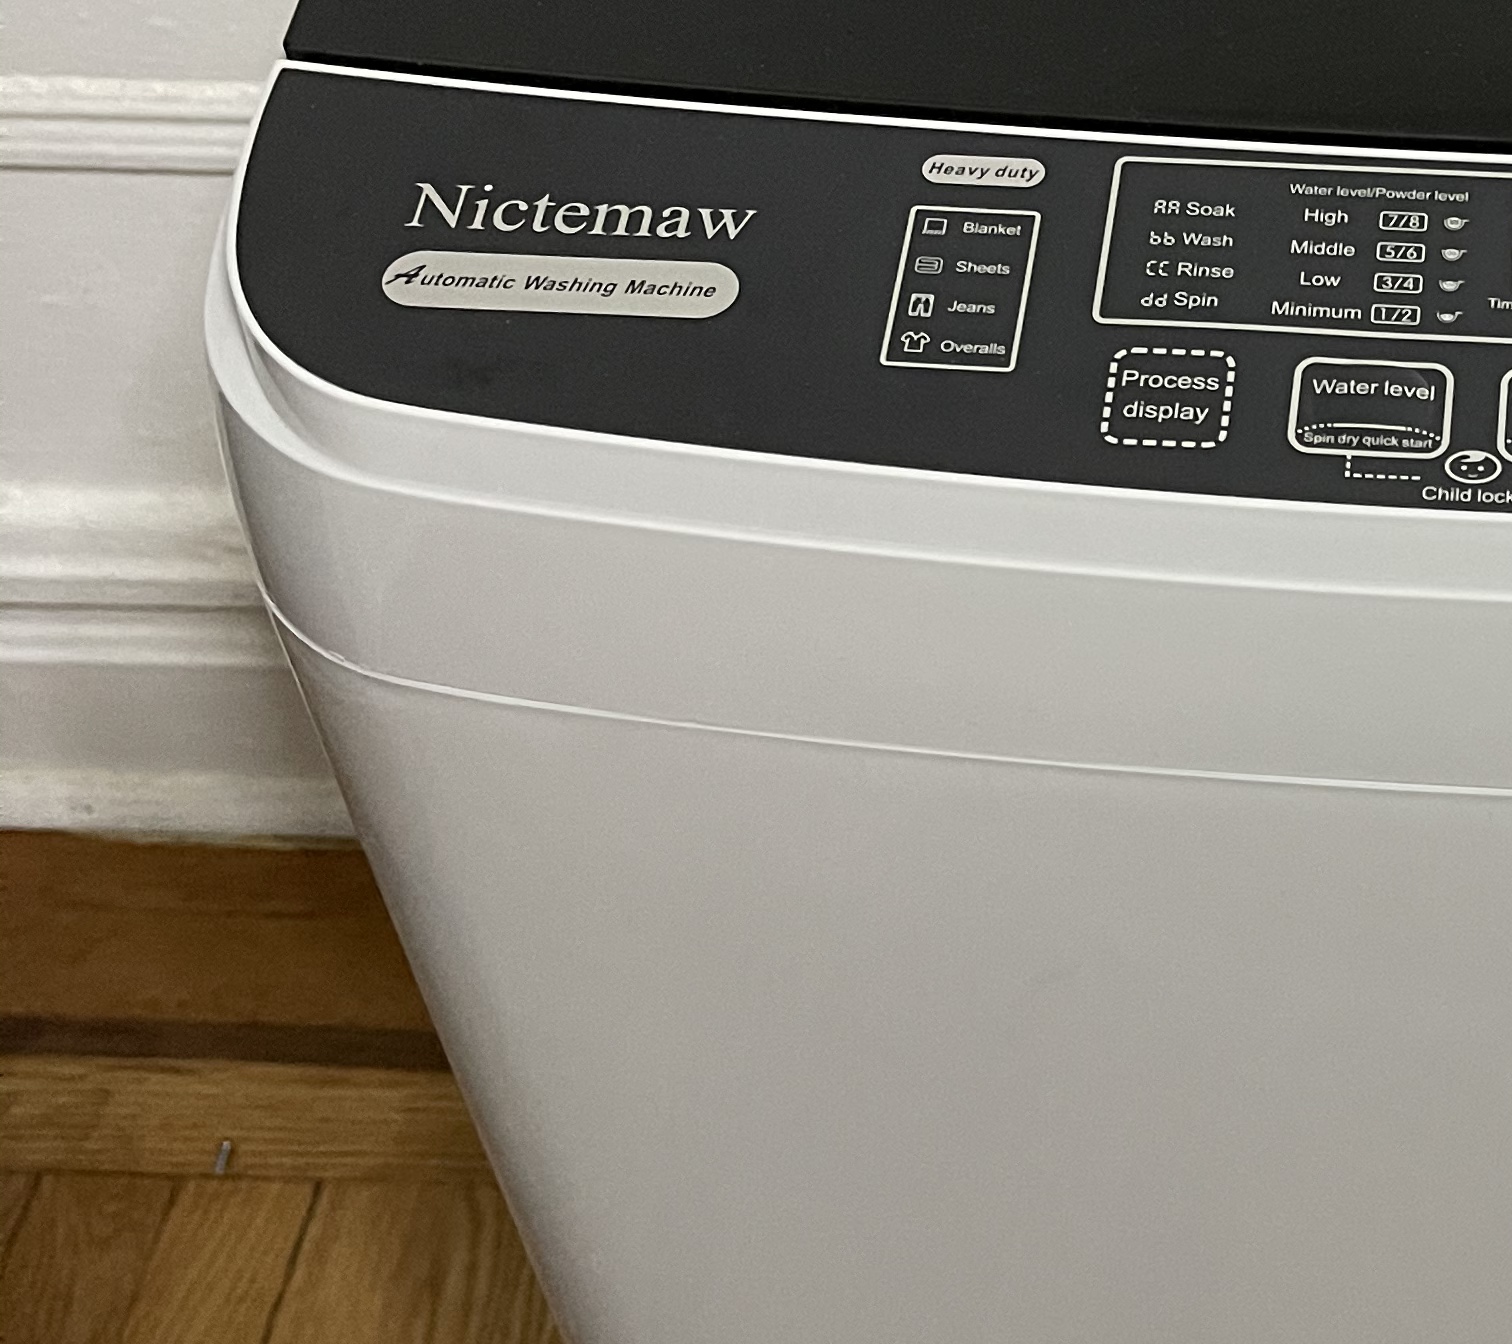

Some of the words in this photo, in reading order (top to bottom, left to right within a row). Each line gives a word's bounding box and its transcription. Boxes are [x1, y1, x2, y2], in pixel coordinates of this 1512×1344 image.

[929, 162, 990, 179] Heavy
[995, 166, 1039, 182] duty
[1290, 184, 1333, 195] Water
[1337, 186, 1431, 200] level/Powder
[1435, 191, 1468, 201] level
[405, 183, 757, 239] Nictemaw
[1186, 202, 1235, 216] Soak
[1305, 208, 1348, 226] High
[1389, 214, 1419, 229] 7/8
[963, 222, 1021, 235] Blanket
[1183, 233, 1233, 246] Wash
[1291, 240, 1355, 256] Middle
[1385, 245, 1417, 260] 5/6
[956, 261, 1009, 274] Sheets
[1178, 262, 1234, 278] Rinse
[385, 264, 515, 291] Automatic
[525, 276, 617, 297] Washing
[625, 280, 716, 297] Machine
[1300, 272, 1341, 286] Low
[1382, 276, 1415, 290] 3/4
[948, 301, 995, 313] Jeans
[1174, 292, 1218, 309] Spin
[1272, 301, 1361, 319] Minimum
[1379, 307, 1412, 322] 1/2
[941, 340, 1005, 354] Overalls
[1122, 370, 1219, 390] Process
[1313, 379, 1379, 394] Water
[1385, 380, 1435, 401] level
[1123, 401, 1209, 424] display
[1304, 432, 1334, 444] Spin
[1338, 435, 1359, 446] dry
[1363, 435, 1398, 446] quick
[1402, 439, 1432, 448] start
[1422, 486, 1471, 501] Child
